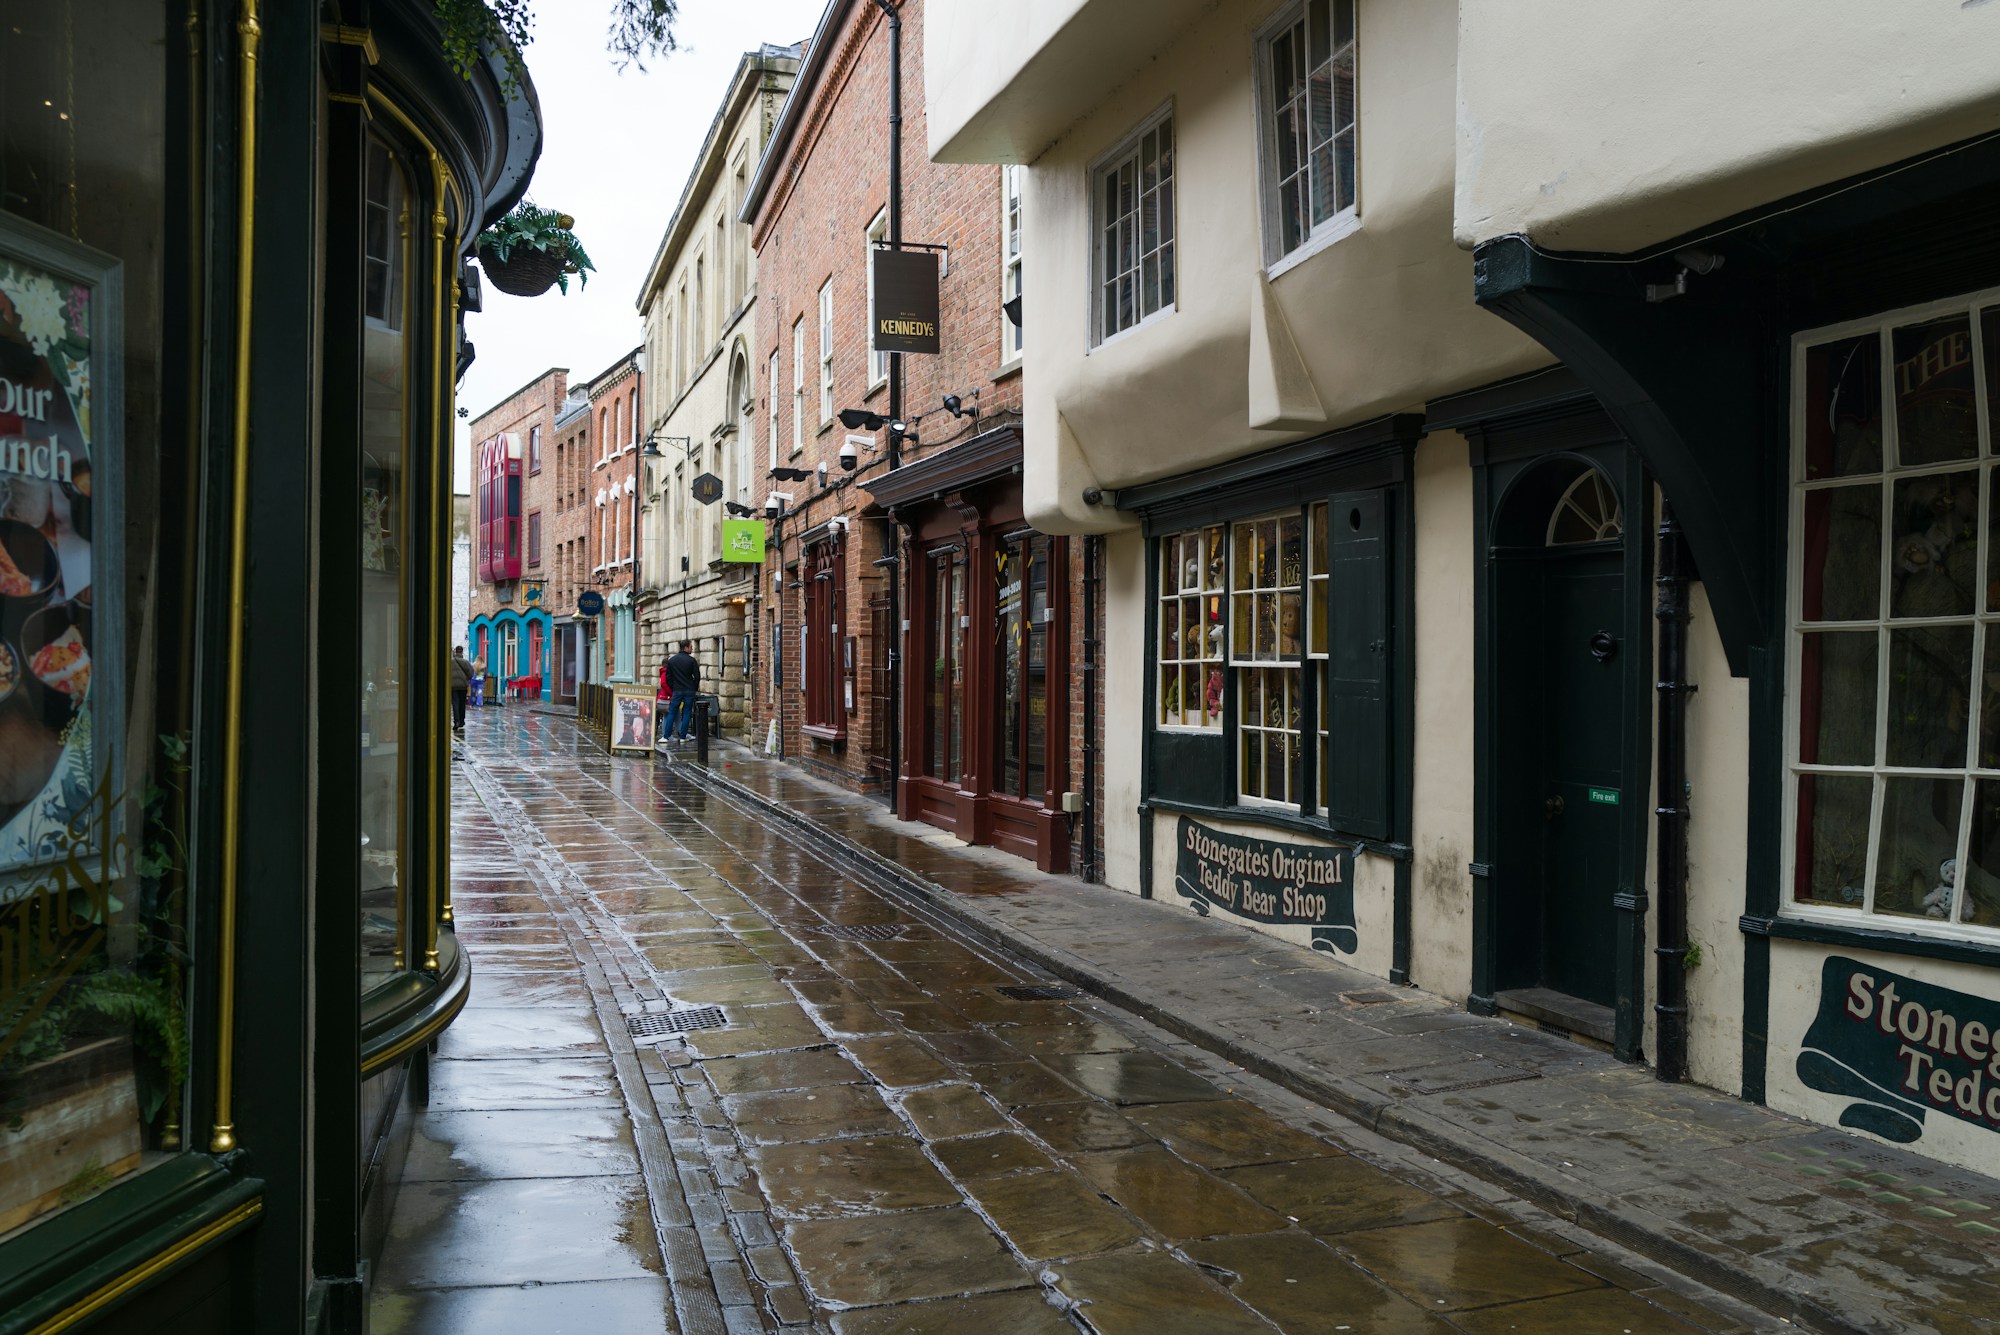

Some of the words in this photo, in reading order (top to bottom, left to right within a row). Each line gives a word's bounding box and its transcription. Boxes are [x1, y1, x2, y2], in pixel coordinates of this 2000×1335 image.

[1894, 330, 1971, 396] THE
[703, 481, 713, 495] M
[1592, 791, 1604, 801] Fire
[1604, 793, 1616, 802] exit
[1186, 824, 1270, 878] Stonegate's
[1271, 847, 1343, 889] Original
[1197, 859, 1239, 909] Teddy
[1242, 879, 1277, 916] Bear
[1282, 886, 1328, 923] Shop
